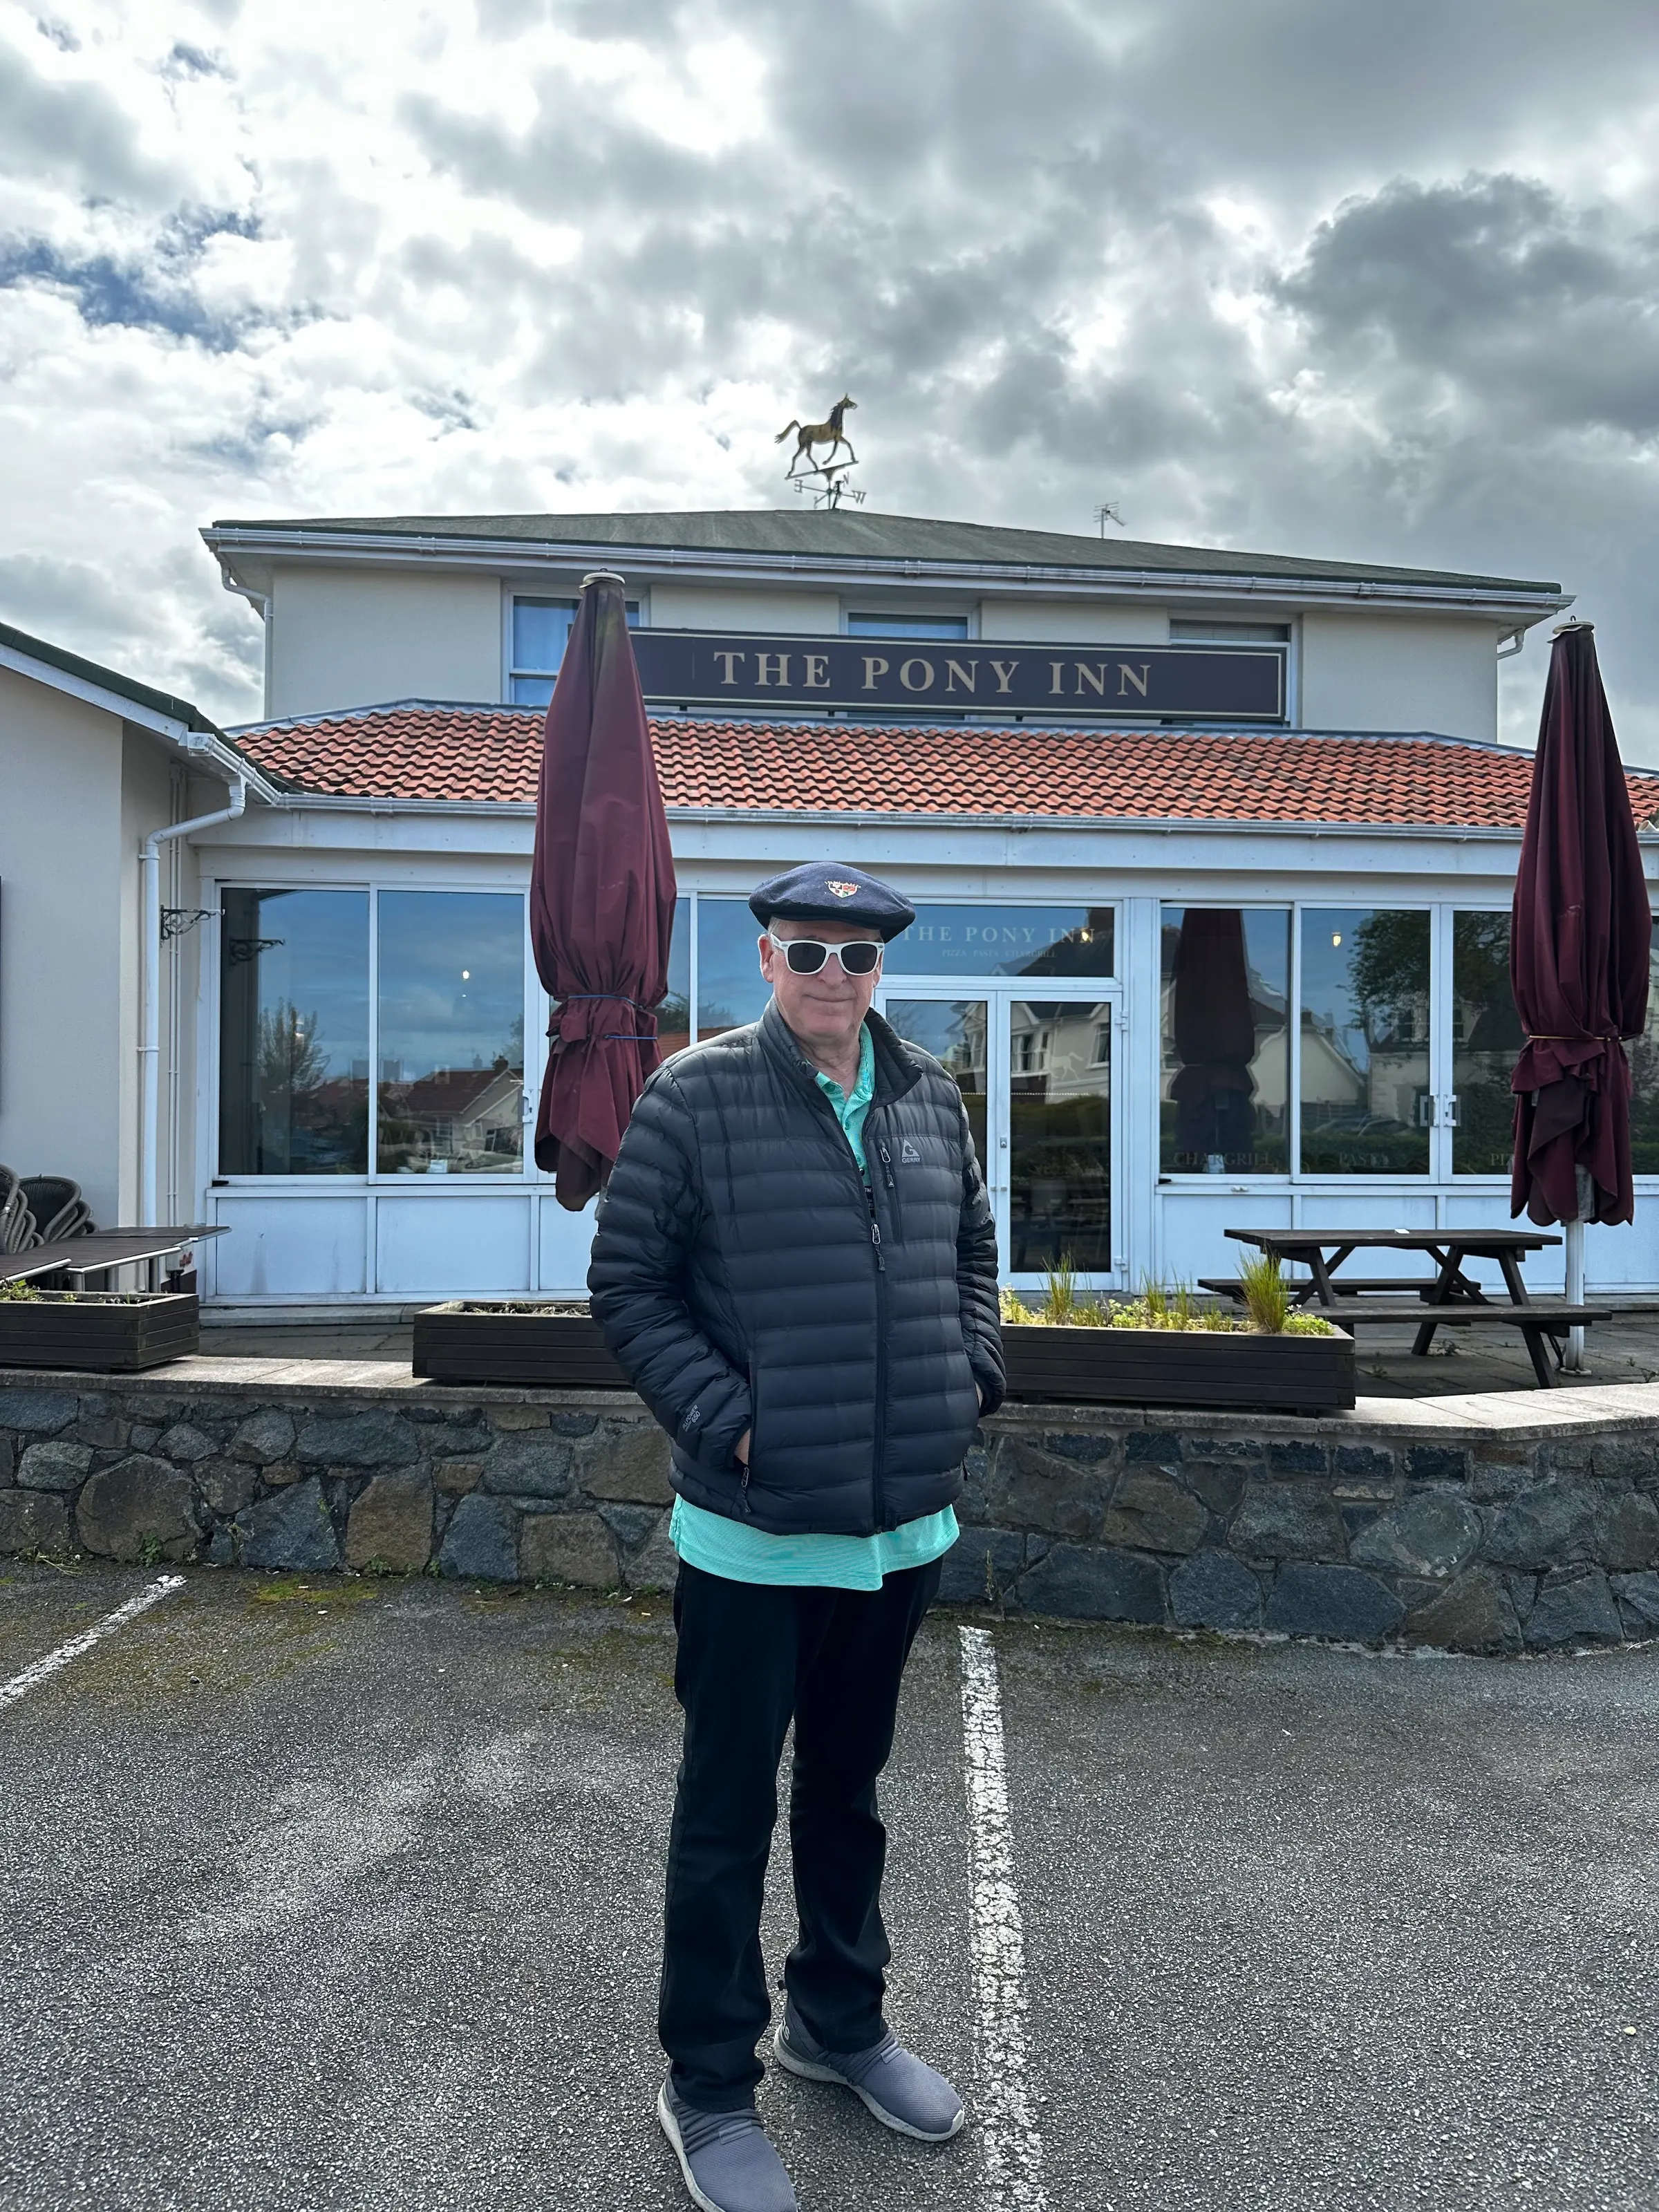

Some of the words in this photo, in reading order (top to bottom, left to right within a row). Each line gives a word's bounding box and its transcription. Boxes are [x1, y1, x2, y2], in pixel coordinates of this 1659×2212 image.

[713, 652, 830, 688] THE
[861, 657, 1020, 693] PONY
[1048, 662, 1152, 697] INN
[902, 926, 953, 941] THE
[965, 926, 1037, 943] PONY
[1049, 927, 1095, 944] INN
[1173, 1152, 1275, 1166] CHARGRILL
